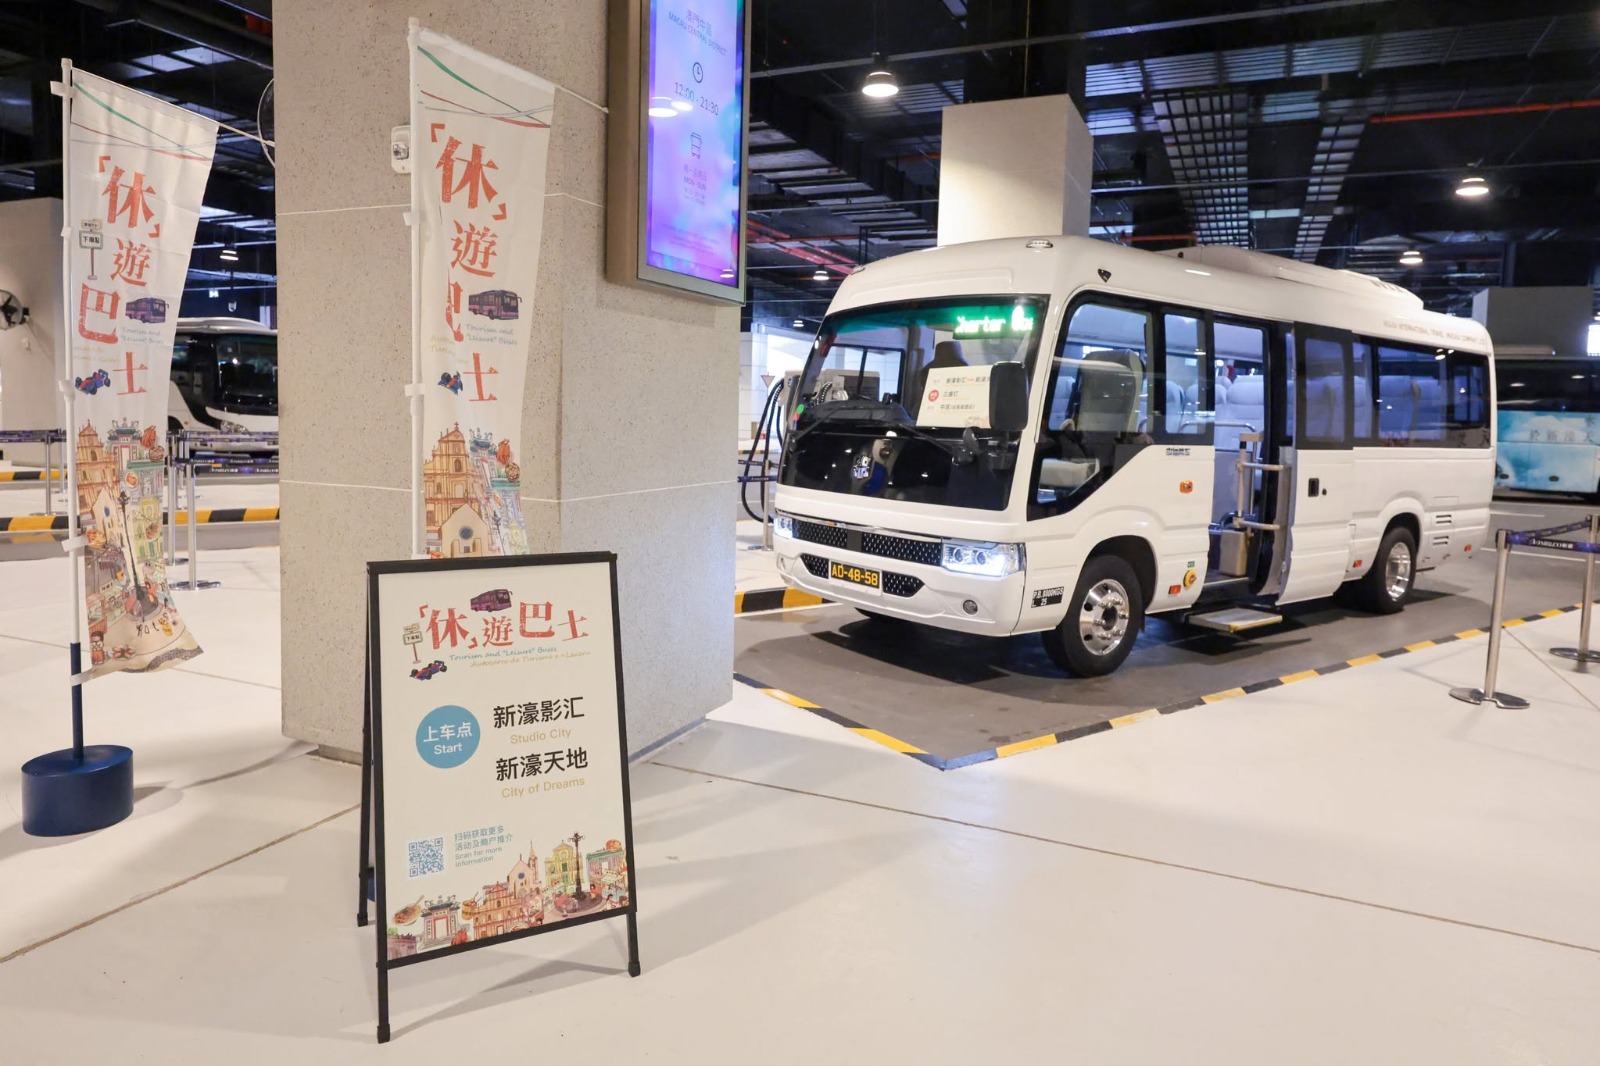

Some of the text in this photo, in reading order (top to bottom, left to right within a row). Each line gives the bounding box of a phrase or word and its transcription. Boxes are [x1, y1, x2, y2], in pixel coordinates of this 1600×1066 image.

[674, 82, 695, 102] 12:00
[700, 96, 719, 116] 21:30
[831, 563, 878, 586] AD-48-58
[449, 653, 482, 661] Tourism
[537, 646, 557, 654] Buses
[493, 696, 585, 729] 新濠影汇
[423, 722, 472, 743] 上车点
[510, 728, 572, 745] Studio City
[434, 743, 463, 755] Start
[495, 746, 588, 782] 新濠天地
[501, 777, 586, 799] City of Dreams
